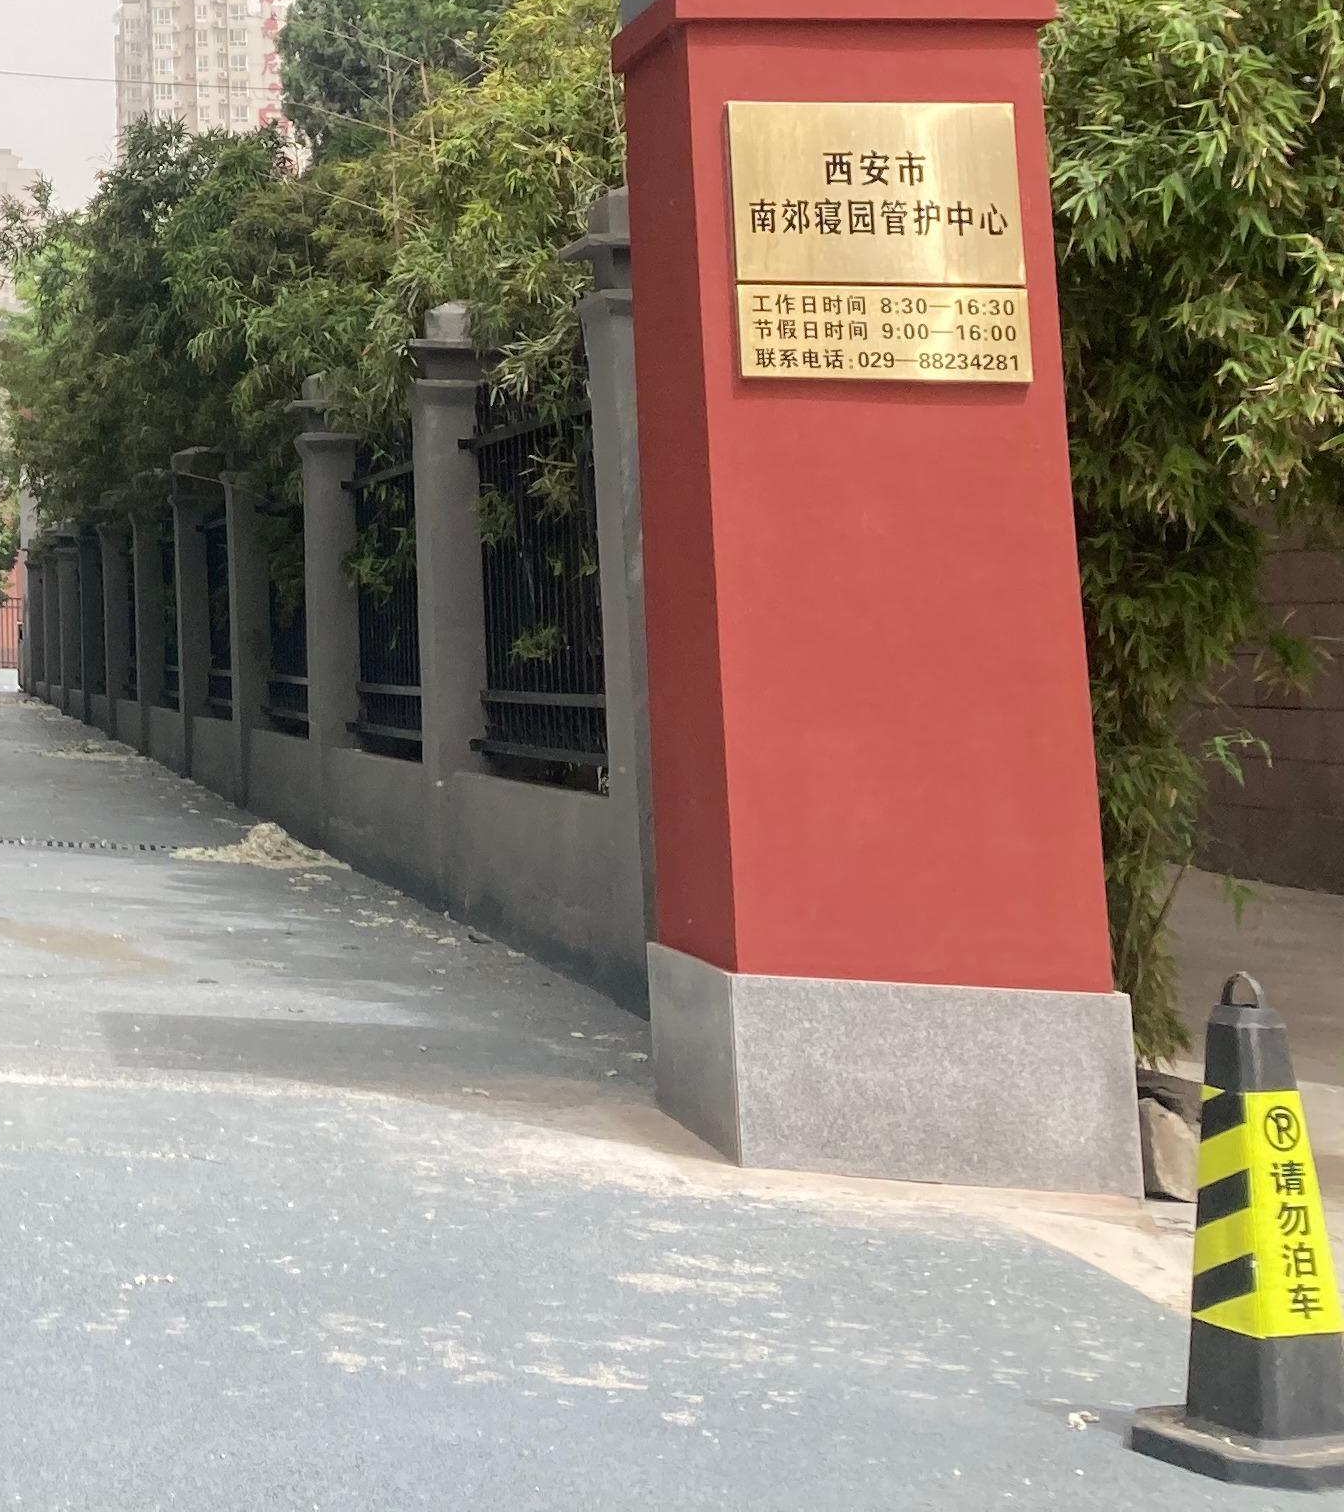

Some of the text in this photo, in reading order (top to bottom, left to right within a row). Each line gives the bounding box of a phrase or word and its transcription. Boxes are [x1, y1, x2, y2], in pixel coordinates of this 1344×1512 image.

[823, 150, 927, 187] 西安市
[748, 197, 1009, 237] 南郊寝园管护中心
[752, 294, 867, 316] 工作日时间
[753, 318, 869, 341] 节假日时间
[1269, 1159, 1324, 1320] 请勿泊车
